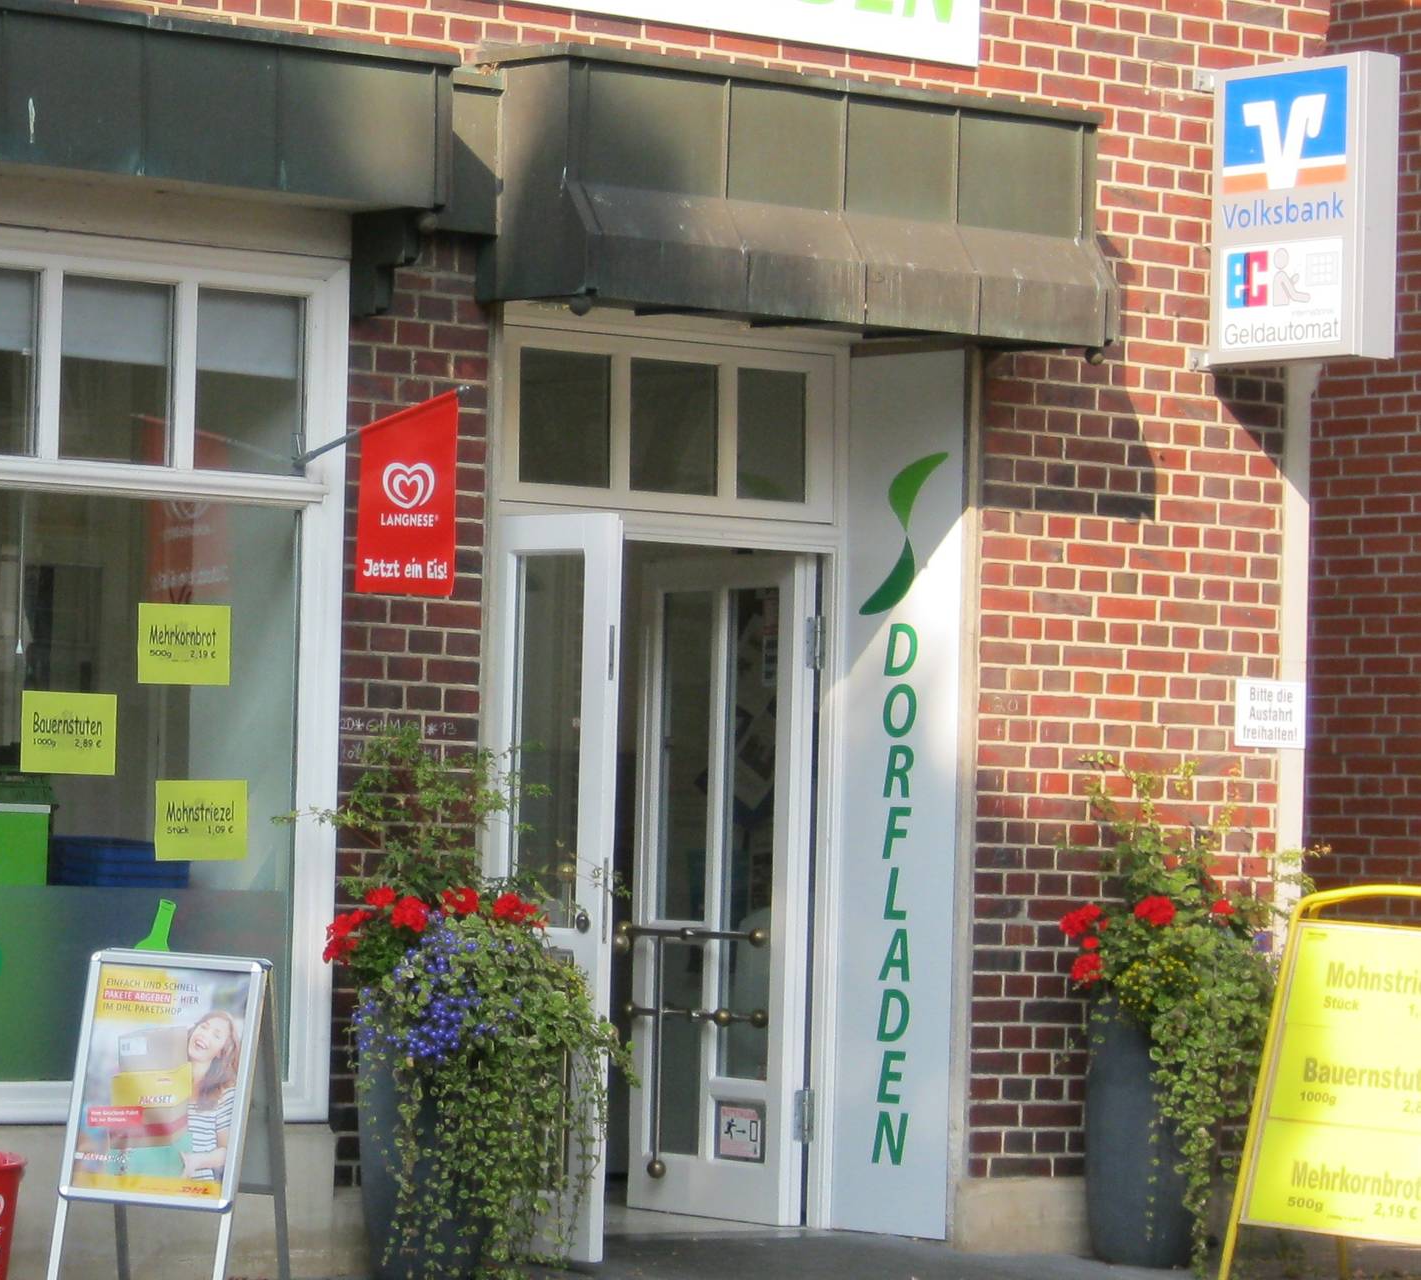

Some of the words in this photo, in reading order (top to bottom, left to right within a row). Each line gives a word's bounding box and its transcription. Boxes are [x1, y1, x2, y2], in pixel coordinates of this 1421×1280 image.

[1223, 193, 1345, 230] Volksbank
[1224, 318, 1339, 345] Geldautomat
[380, 513, 434, 528] LANGNESE
[362, 558, 400, 578] Jetzt
[404, 557, 423, 579] ein
[427, 558, 448, 580] Eis!
[149, 624, 217, 646] Mehrkornbrot
[149, 649, 172, 659] 500g
[1249, 686, 1274, 703] Bitte
[1277, 687, 1294, 704] die
[1249, 705, 1293, 723] Ausfahrt
[33, 711, 103, 736] Bauernstuten
[1243, 725, 1298, 742] freihalten!
[33, 738, 57, 748] 1000g
[166, 800, 234, 823] Mohnstriezel
[871, 622, 919, 1167] DORFLADEN
[106, 977, 140, 989] EINFACH
[143, 980, 162, 990] UND
[164, 982, 200, 993] SCHNELL
[1326, 961, 1421, 995] Mohnstri
[104, 989, 133, 1001] PAKETE
[180, 996, 200, 1005] HIER
[103, 1002, 114, 1011] IM
[116, 1002, 133, 1012] DHL
[135, 1004, 183, 1016] PAKETSHOP
[1300, 1091, 1337, 1106] 1000g
[1287, 1197, 1324, 1213] 500g
[1374, 1202, 1404, 1218] 2,19
